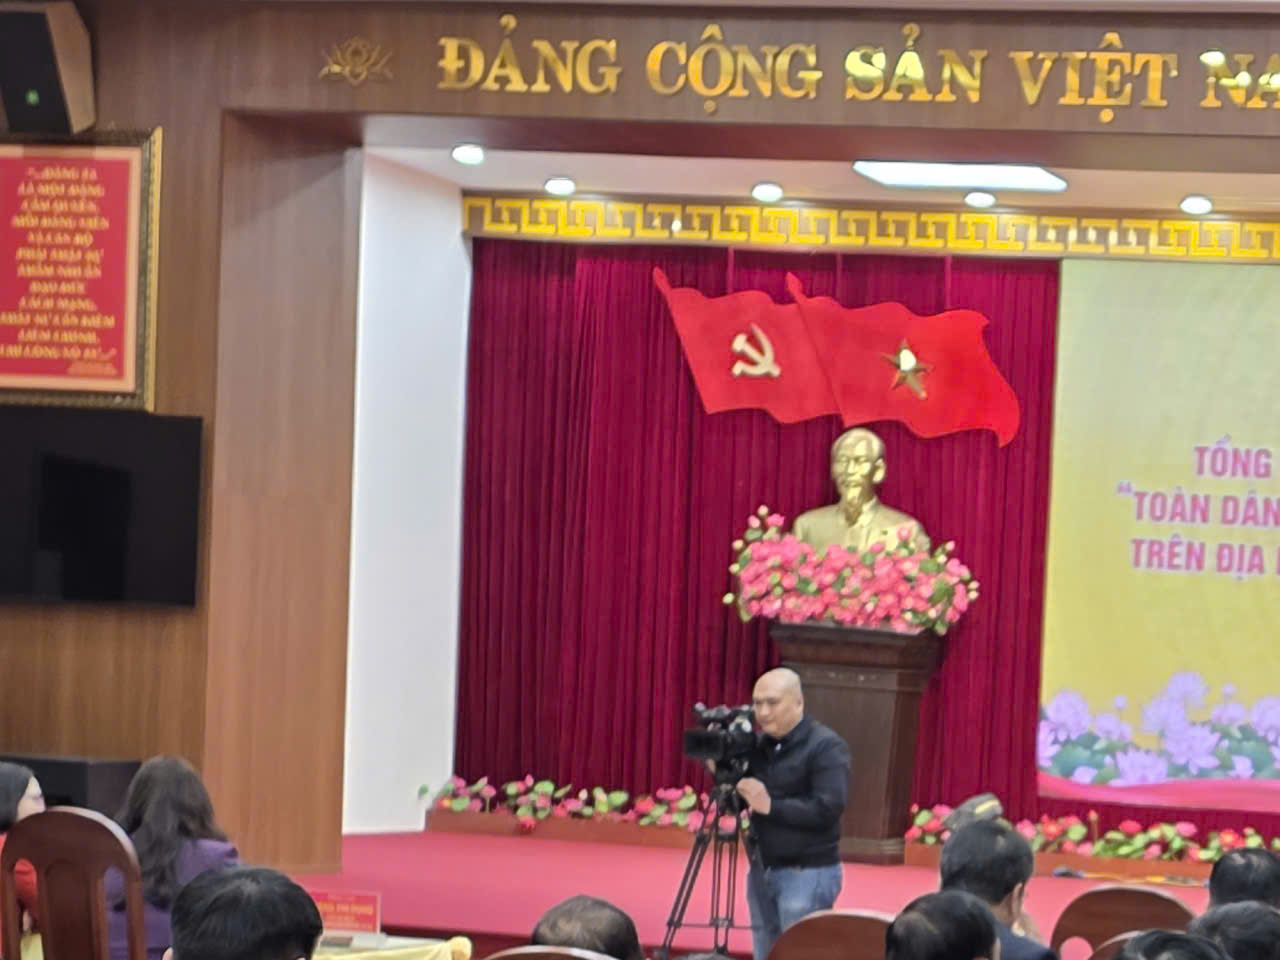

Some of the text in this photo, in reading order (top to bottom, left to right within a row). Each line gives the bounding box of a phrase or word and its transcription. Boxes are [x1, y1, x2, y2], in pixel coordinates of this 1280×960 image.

[437, 15, 622, 94] ĐẢNG
[646, 24, 823, 115] CỘNG
[844, 23, 987, 103] SẢN
[1008, 32, 1178, 123] VIỆT
[1194, 436, 1271, 478] TỔNG
[1131, 533, 1205, 571] TRÊN
[1216, 543, 1265, 581] ĐỊA
